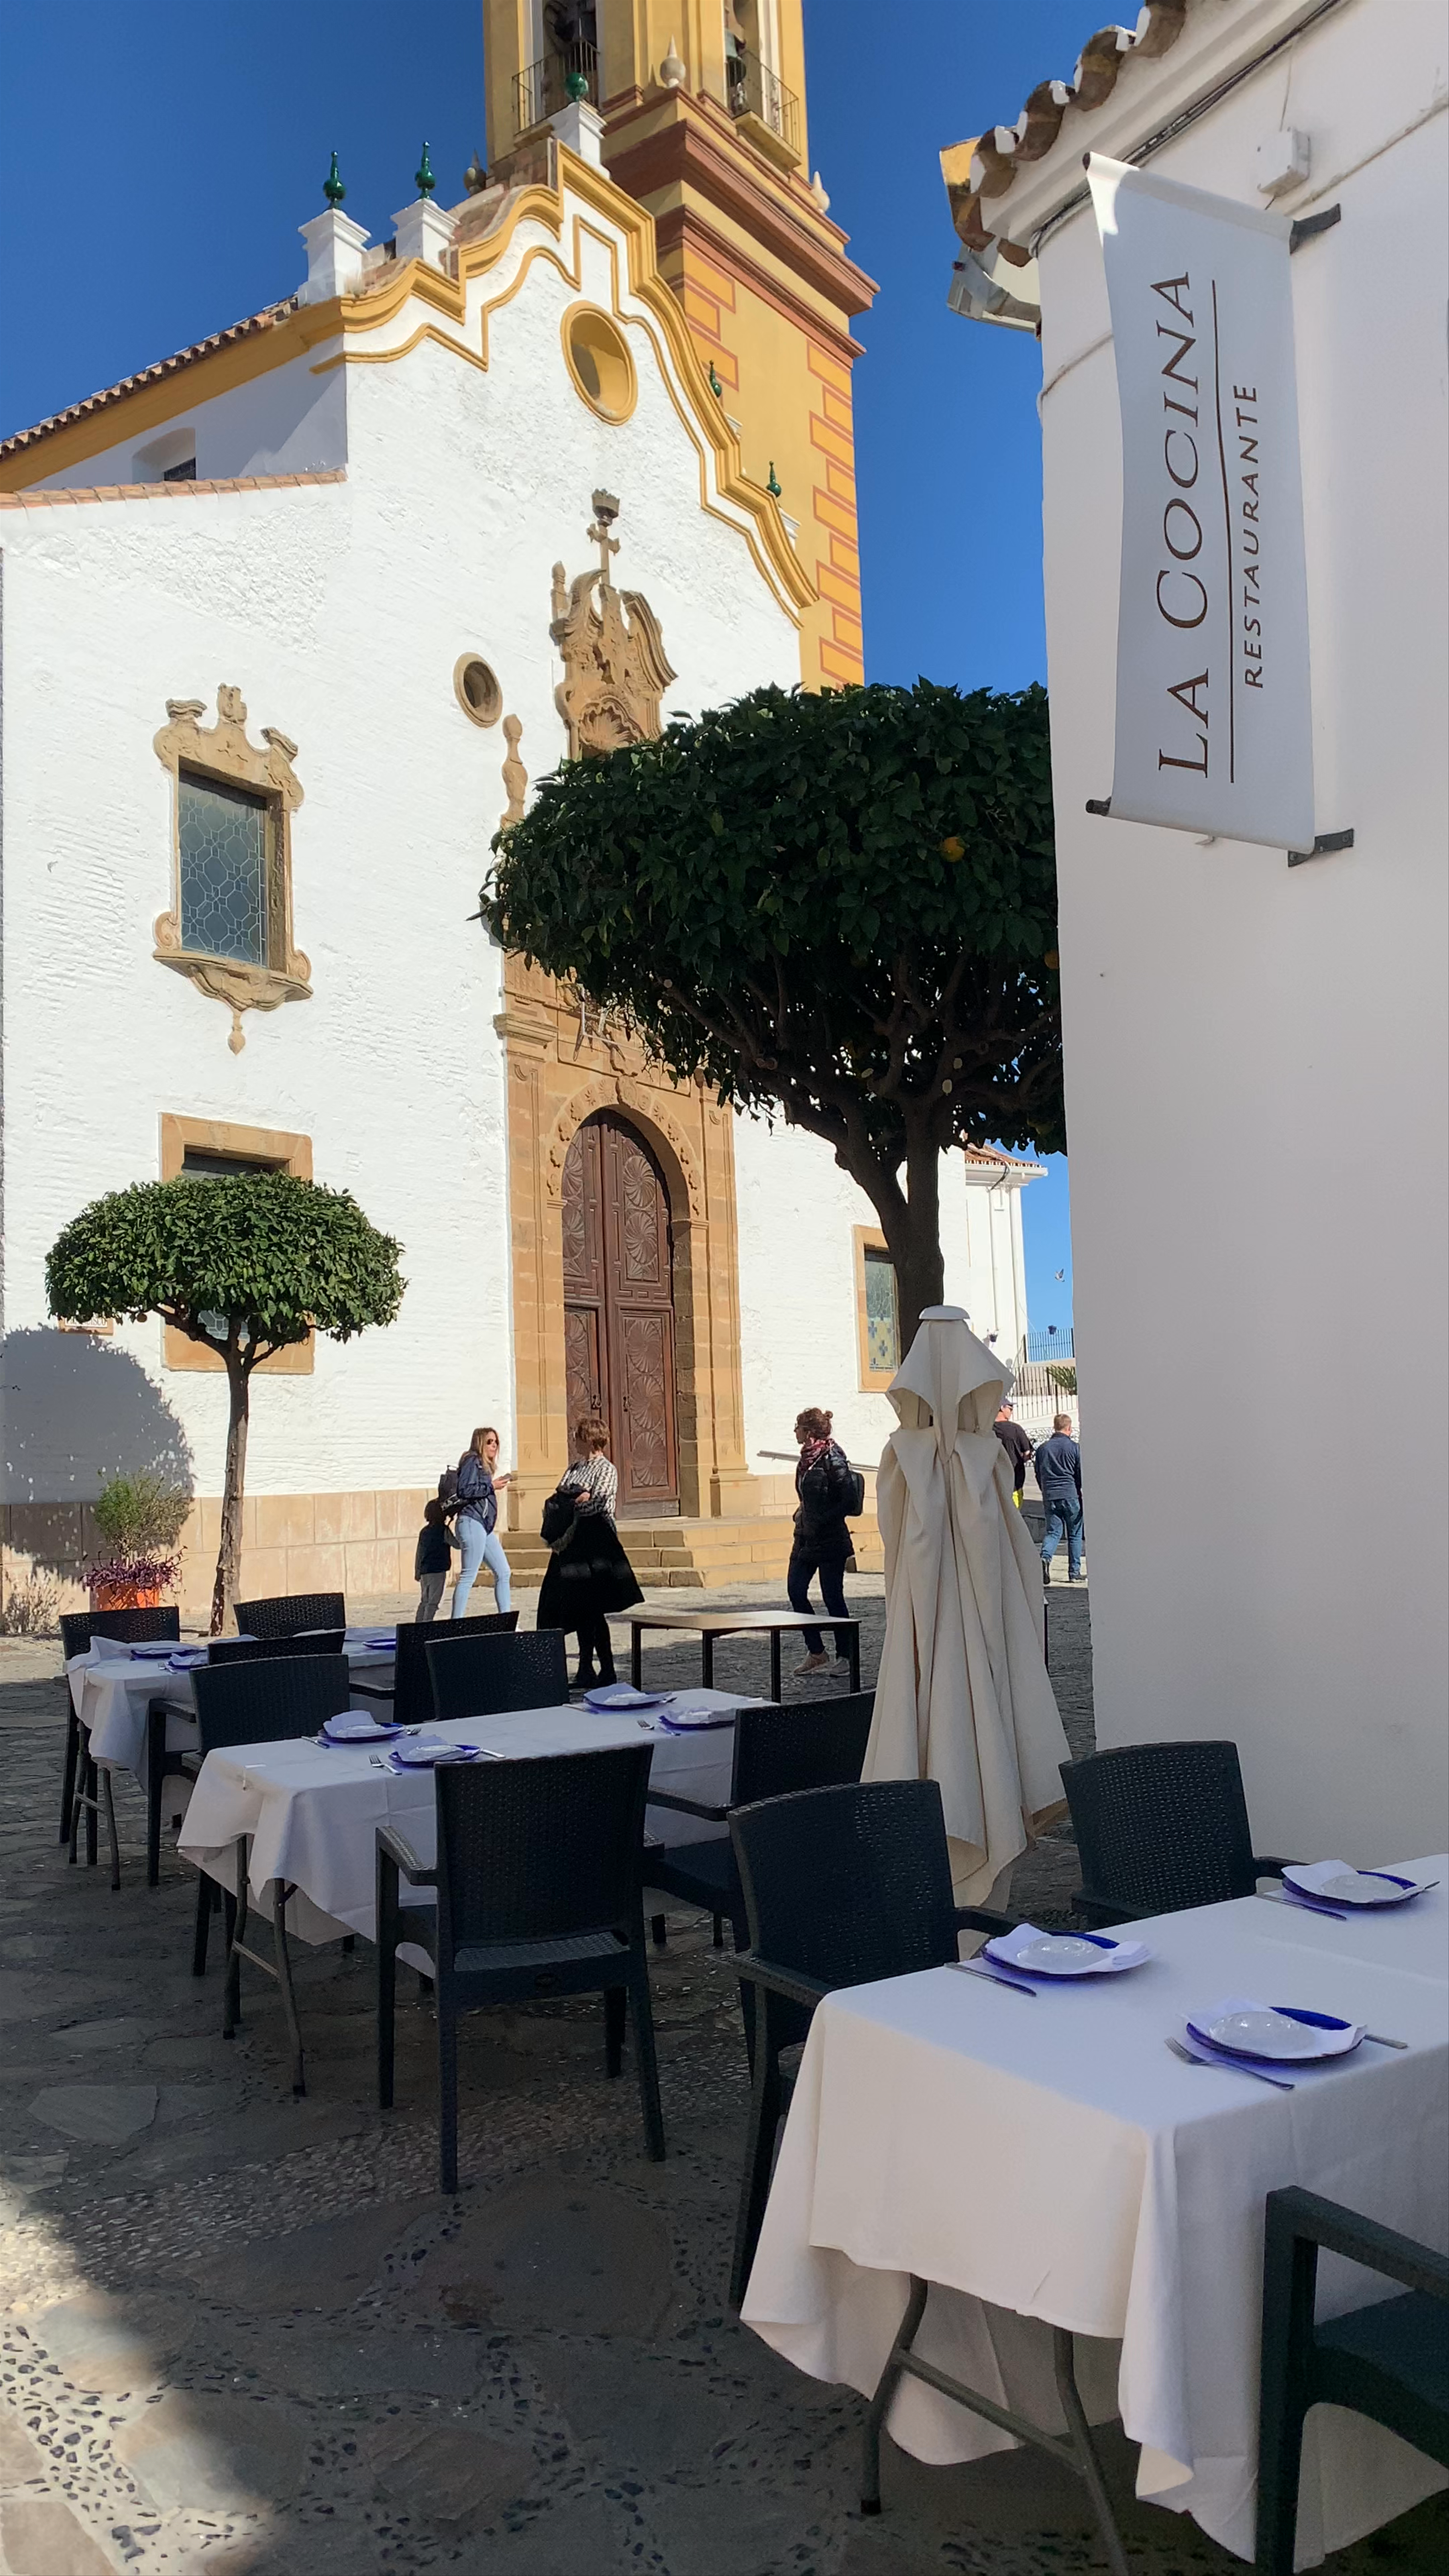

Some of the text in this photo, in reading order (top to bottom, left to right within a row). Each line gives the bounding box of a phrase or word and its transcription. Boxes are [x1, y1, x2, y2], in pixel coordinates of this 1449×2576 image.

[1150, 272, 1209, 778] LA COCINA
[1233, 385, 1263, 688] RESTAURANTE
